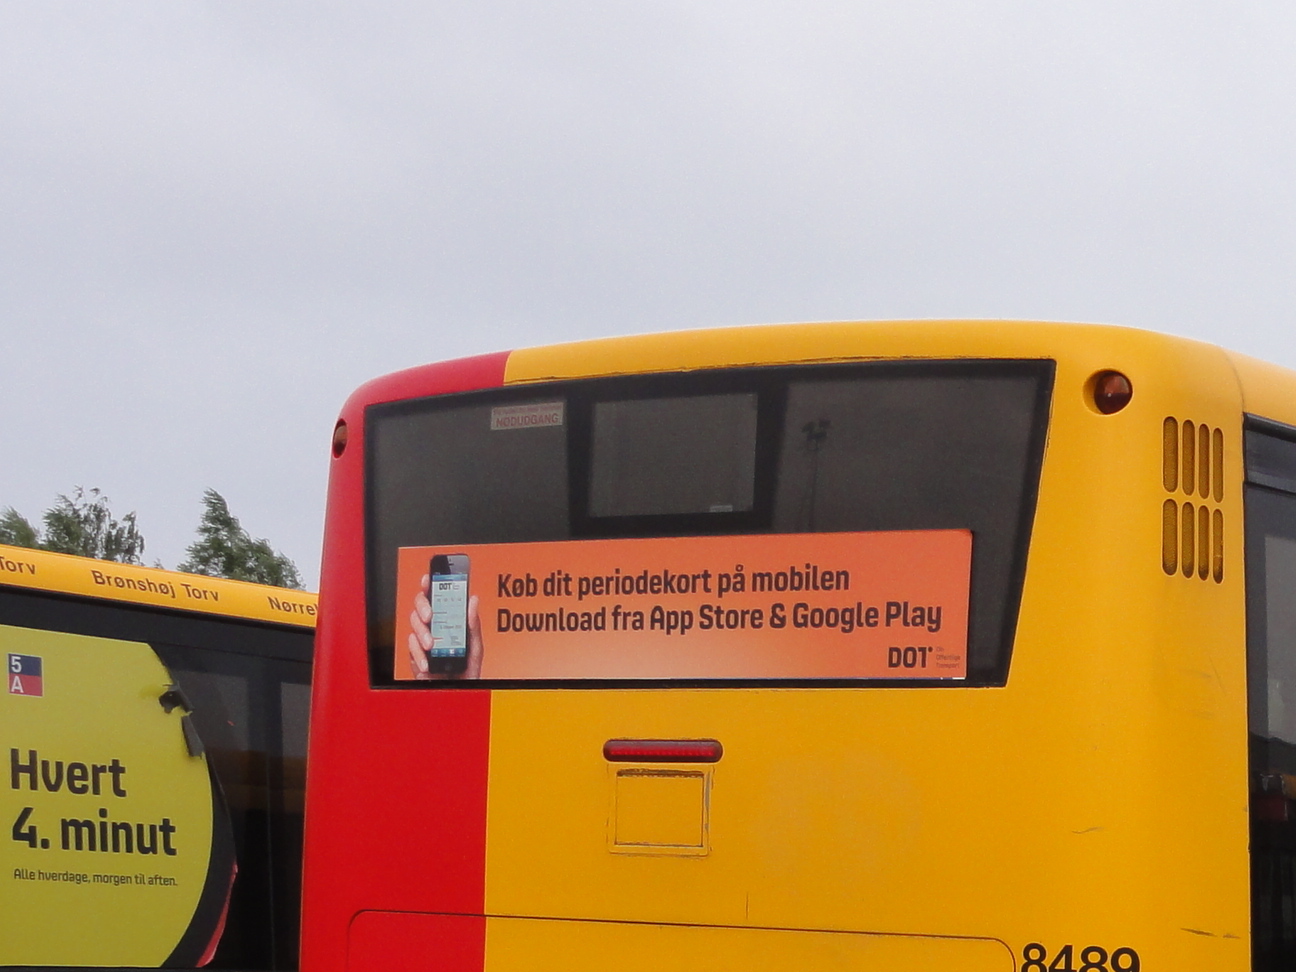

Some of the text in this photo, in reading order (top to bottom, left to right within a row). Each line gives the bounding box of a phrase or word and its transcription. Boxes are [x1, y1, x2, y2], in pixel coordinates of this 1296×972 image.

[92, 570, 220, 601] Brønshøj Torv
[497, 563, 849, 600] Køb dit periodekort på mobilen
[268, 596, 318, 616] Nørre
[497, 601, 942, 635] Download fra App Store & Google Play
[11, 656, 22, 673] 5
[11, 675, 24, 693] A
[10, 748, 127, 798] Hvert
[12, 807, 177, 856] 4. minut
[13, 868, 178, 887] Alle hverdage, morgen til aften.
